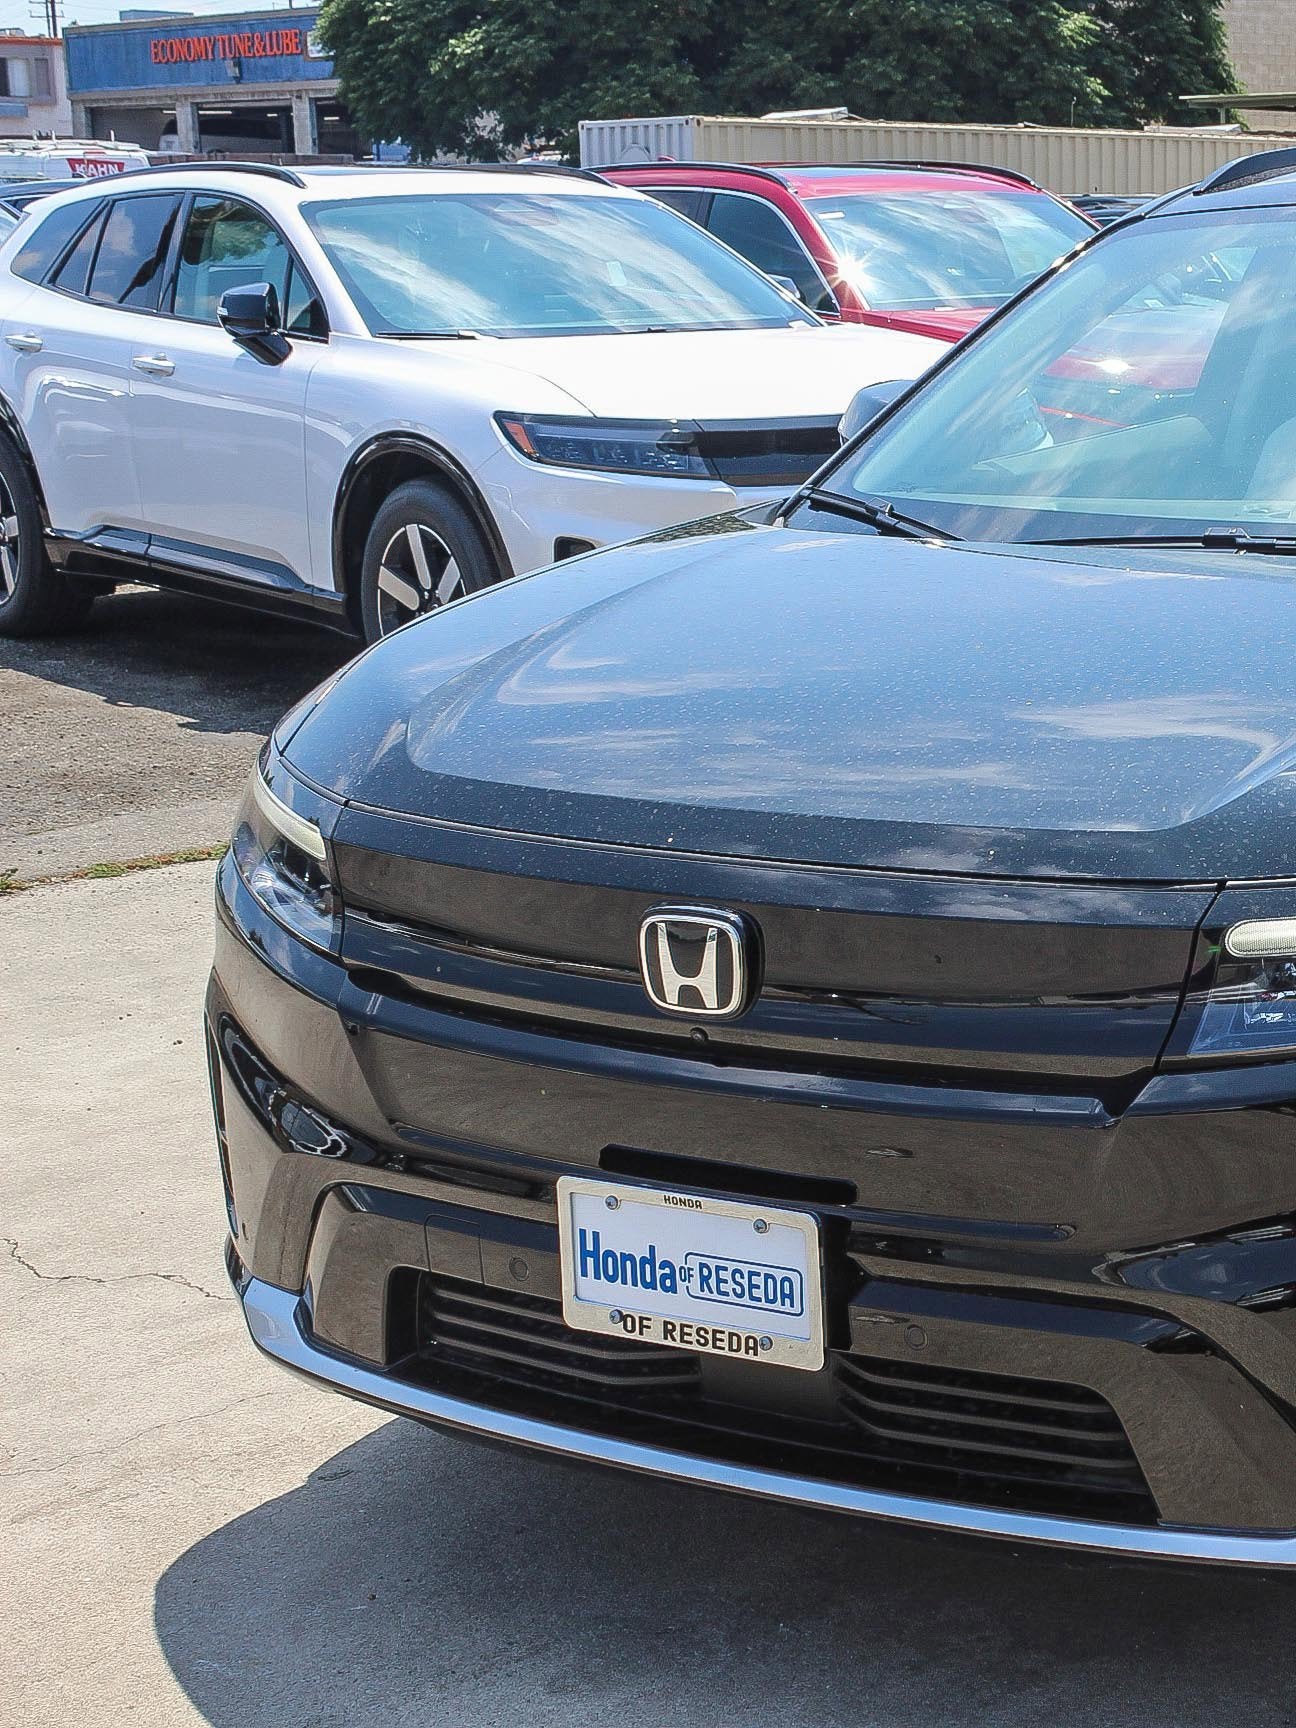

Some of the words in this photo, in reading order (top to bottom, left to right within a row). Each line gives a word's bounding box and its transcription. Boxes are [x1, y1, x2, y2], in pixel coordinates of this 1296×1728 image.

[150, 37, 216, 65] ECONOMY
[74, 163, 120, 178] KAHN
[663, 1194, 703, 1210] HONDA
[578, 1227, 678, 1295] Honda
[678, 1264, 695, 1284] OF
[698, 1261, 795, 1308] RESEDA
[622, 1313, 652, 1336] OF
[662, 1319, 759, 1357] RESEDA
